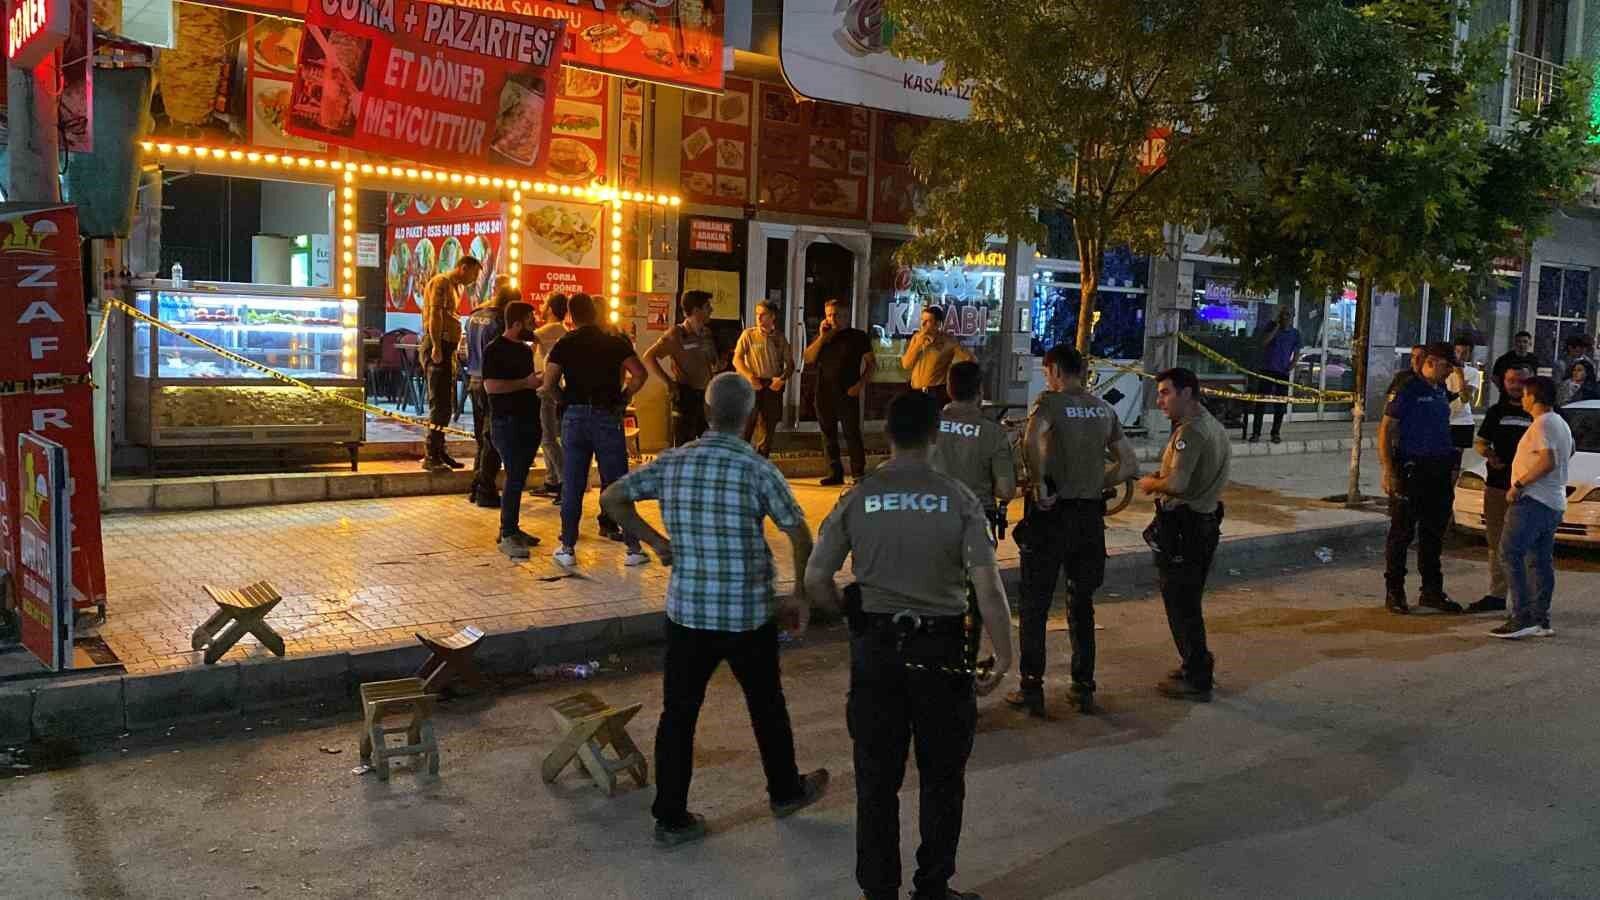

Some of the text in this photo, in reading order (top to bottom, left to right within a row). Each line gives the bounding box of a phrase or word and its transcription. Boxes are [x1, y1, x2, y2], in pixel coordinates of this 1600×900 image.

[384, 48, 485, 105] ET DÖNER
[363, 96, 487, 156] MEVCUTTUR
[539, 282, 551, 291] ET
[887, 301, 988, 337] KAABI
[864, 492, 949, 513] BEKÇİ
